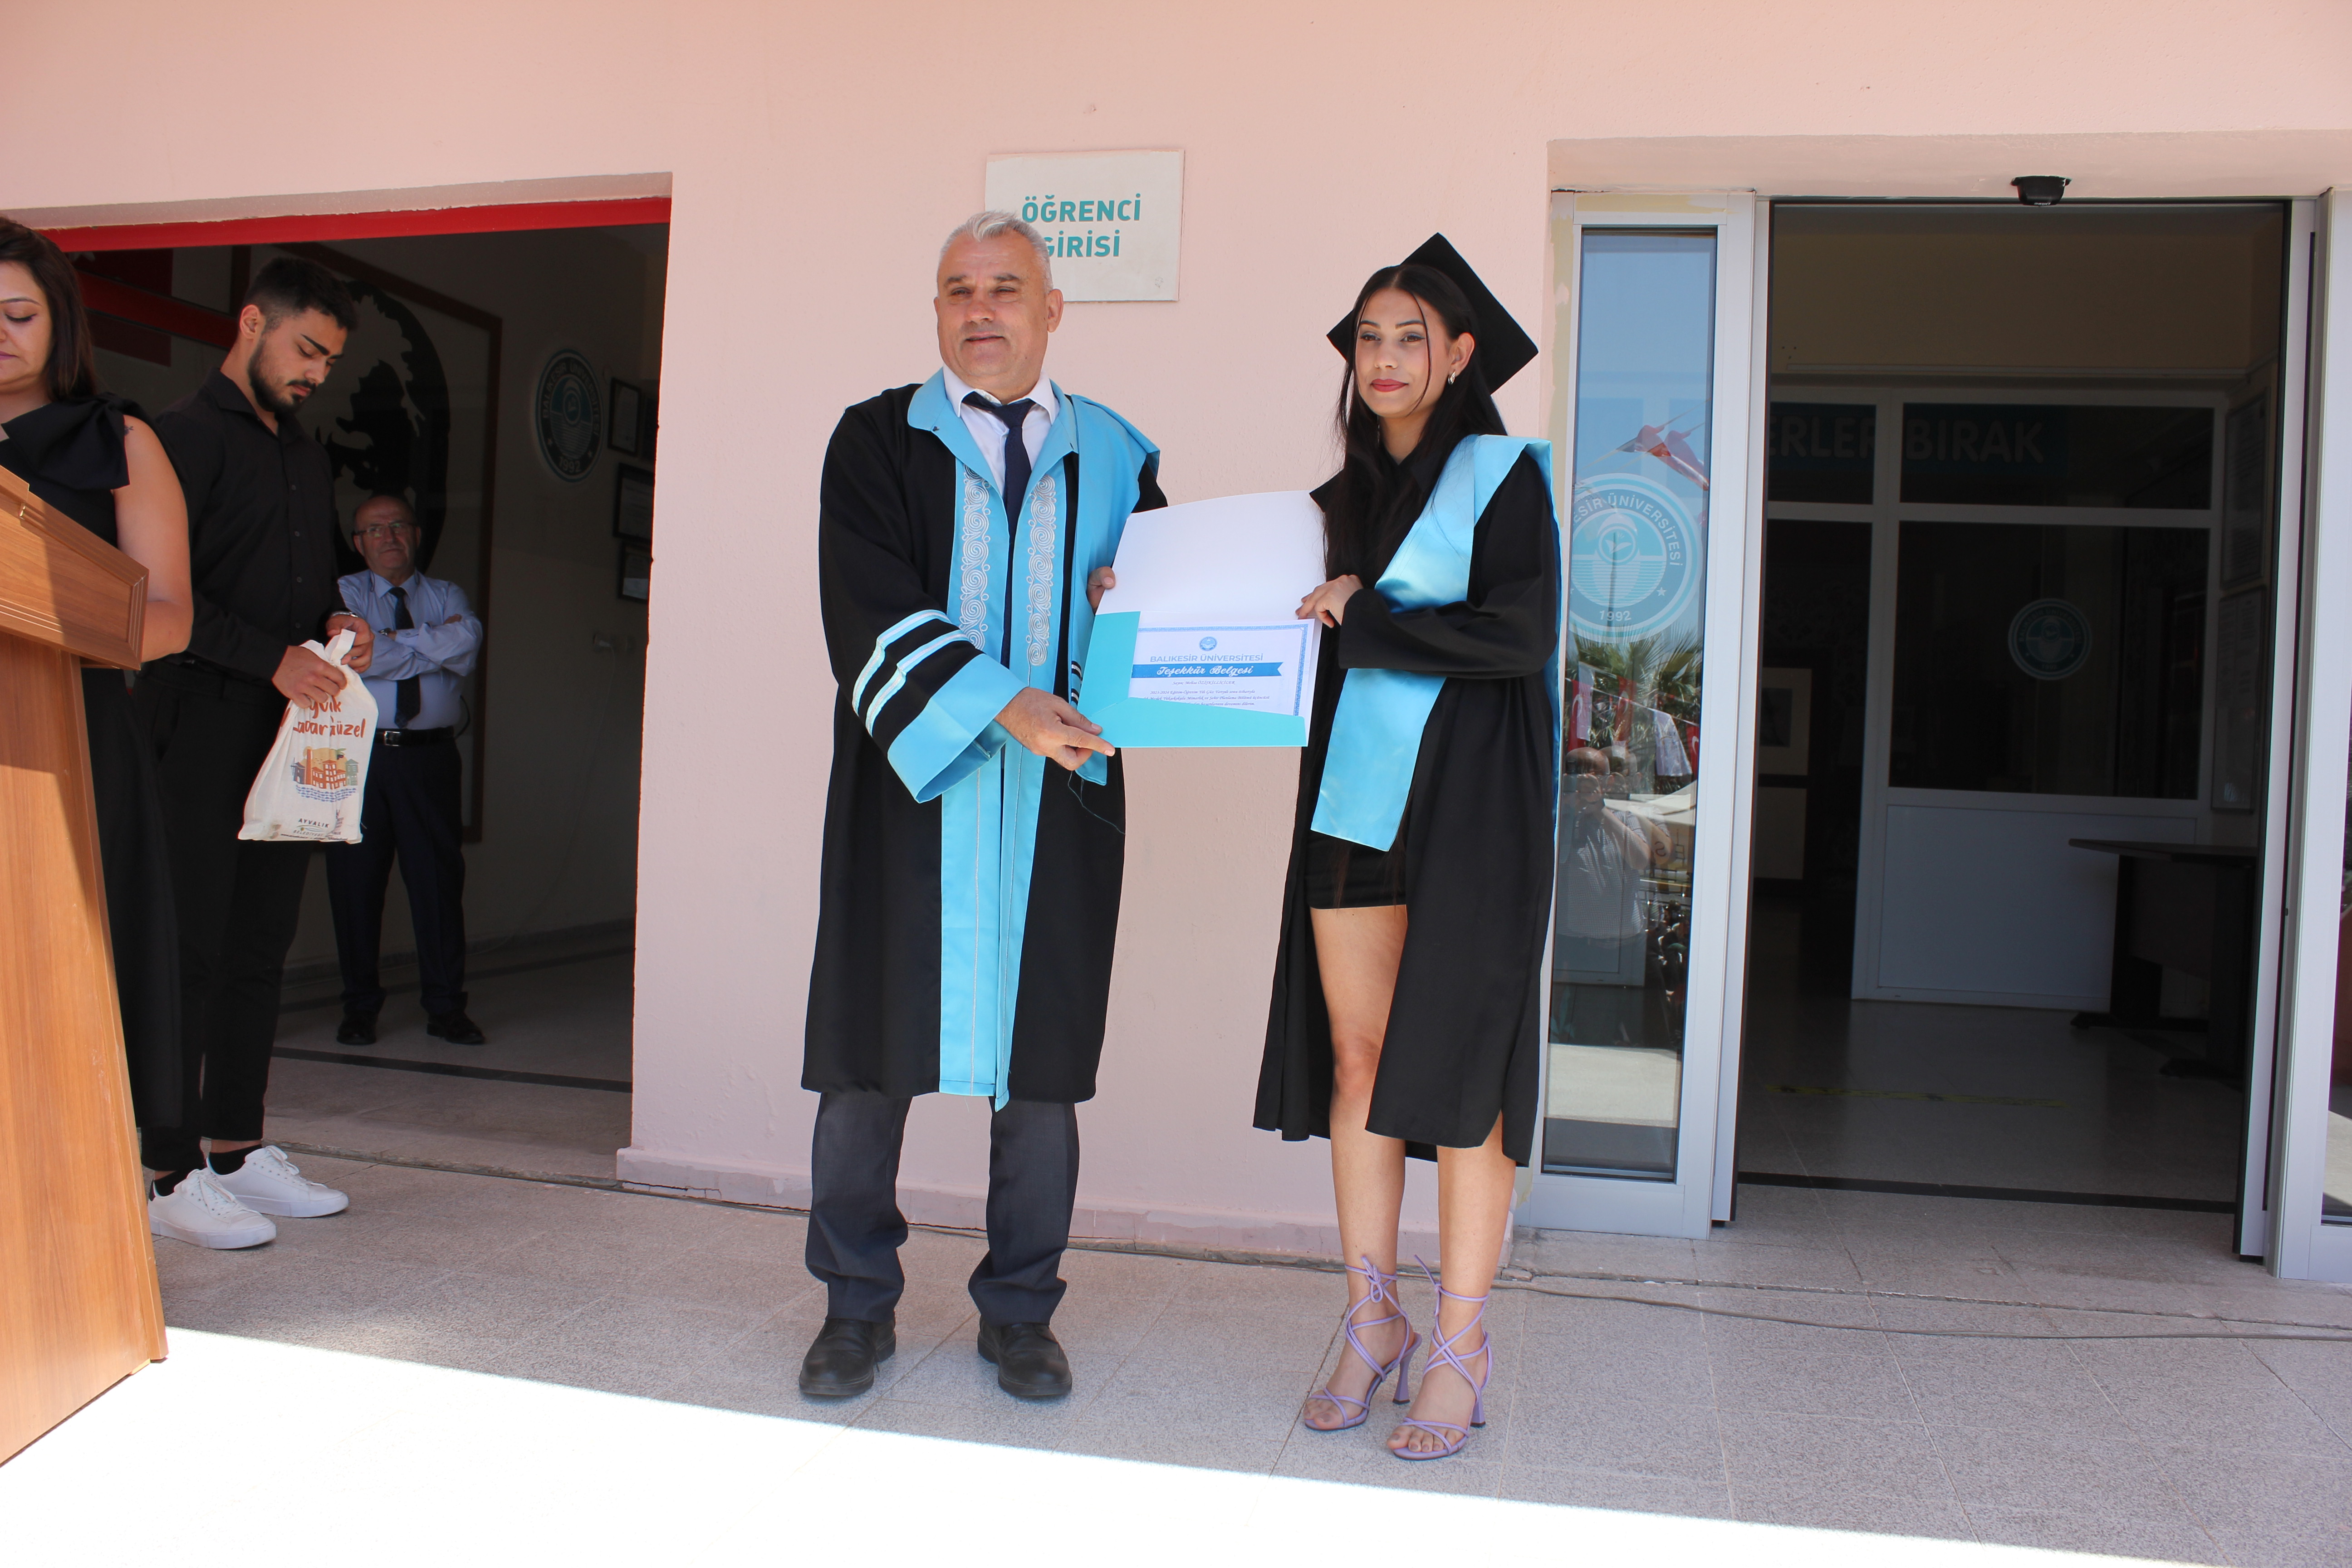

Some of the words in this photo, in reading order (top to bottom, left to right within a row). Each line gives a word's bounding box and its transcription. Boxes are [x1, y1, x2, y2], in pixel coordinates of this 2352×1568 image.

[1022, 193, 1142, 223] ÖĞRENCİ
[1906, 417, 2044, 464] BIRAK
[559, 455, 582, 473] 1992
[1608, 492, 1683, 566] ÜNİVERSİTESİ
[1599, 610, 1632, 622] 1992
[1150, 654, 1198, 662] BALIKESİR
[1200, 653, 1264, 662] ÜNİVERSİTESİ
[1157, 666, 1206, 677] Teşekkür
[1209, 665, 1254, 677] Belgesi
[298, 818, 330, 828] AYVALIK
